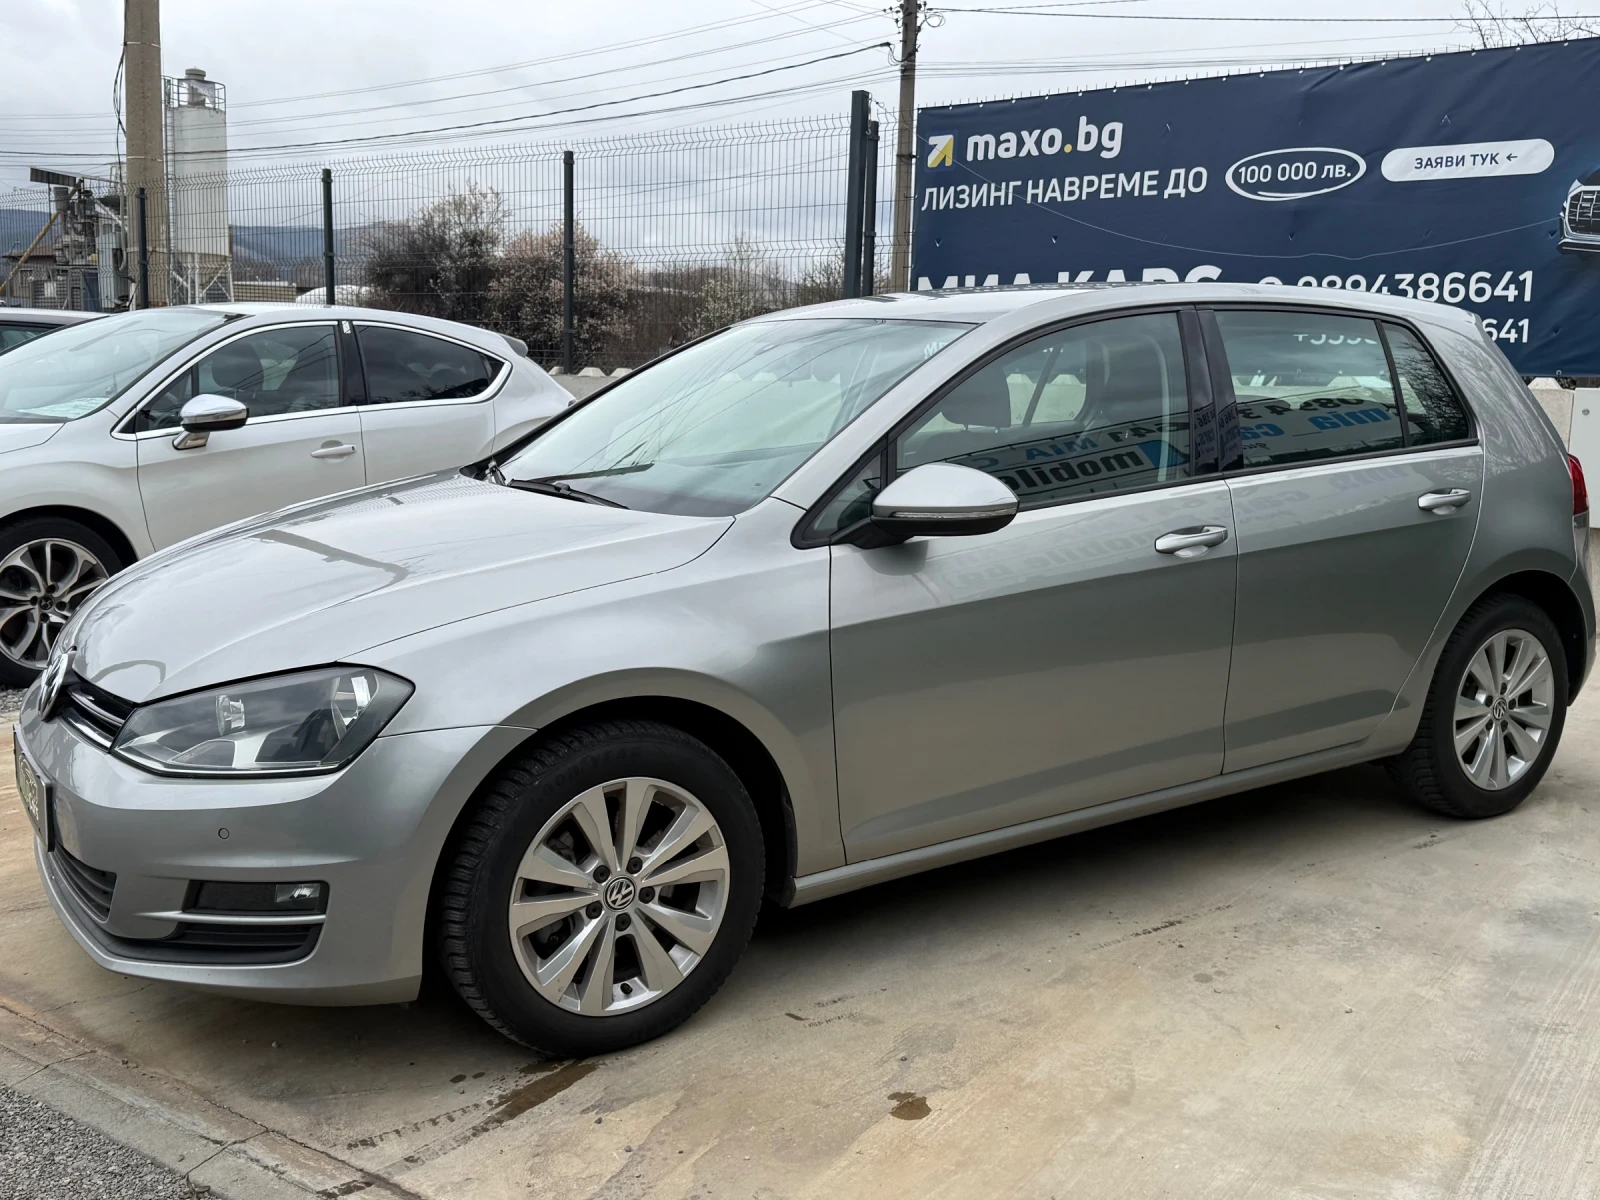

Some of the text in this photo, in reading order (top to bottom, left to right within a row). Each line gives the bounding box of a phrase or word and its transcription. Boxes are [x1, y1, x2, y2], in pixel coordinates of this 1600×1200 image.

[966, 116, 1123, 159] maxo.bg
[1238, 161, 1352, 184] 100 000 лв.
[1414, 152, 1500, 170] ЗАЯВИ ТУК
[921, 166, 1208, 212] ЛИЗИНГ НАВРЕМЕ ДО
